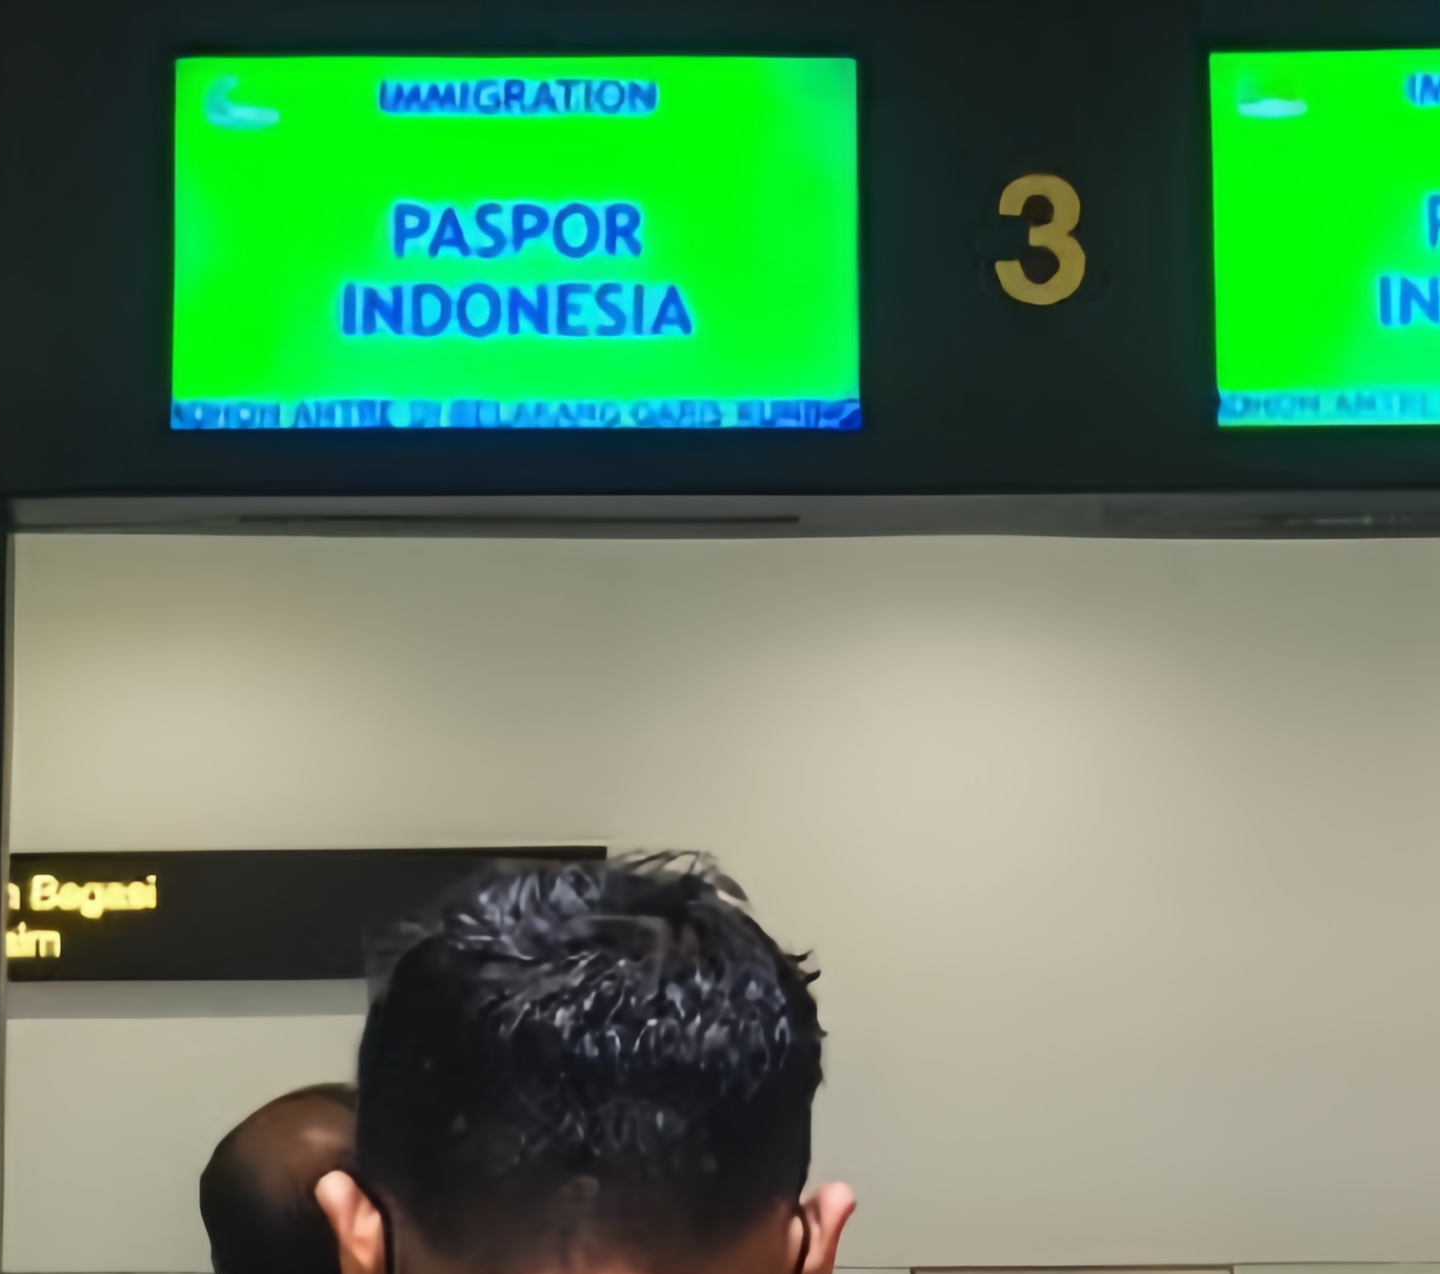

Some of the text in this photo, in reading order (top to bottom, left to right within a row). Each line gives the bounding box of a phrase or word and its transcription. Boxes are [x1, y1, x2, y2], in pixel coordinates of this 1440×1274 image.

[379, 79, 657, 115] IMMIGRATION
[393, 203, 643, 260] PASPOR
[996, 175, 1086, 306] 3
[342, 283, 693, 338] INDONESIA
[30, 874, 157, 919] Bagasi
